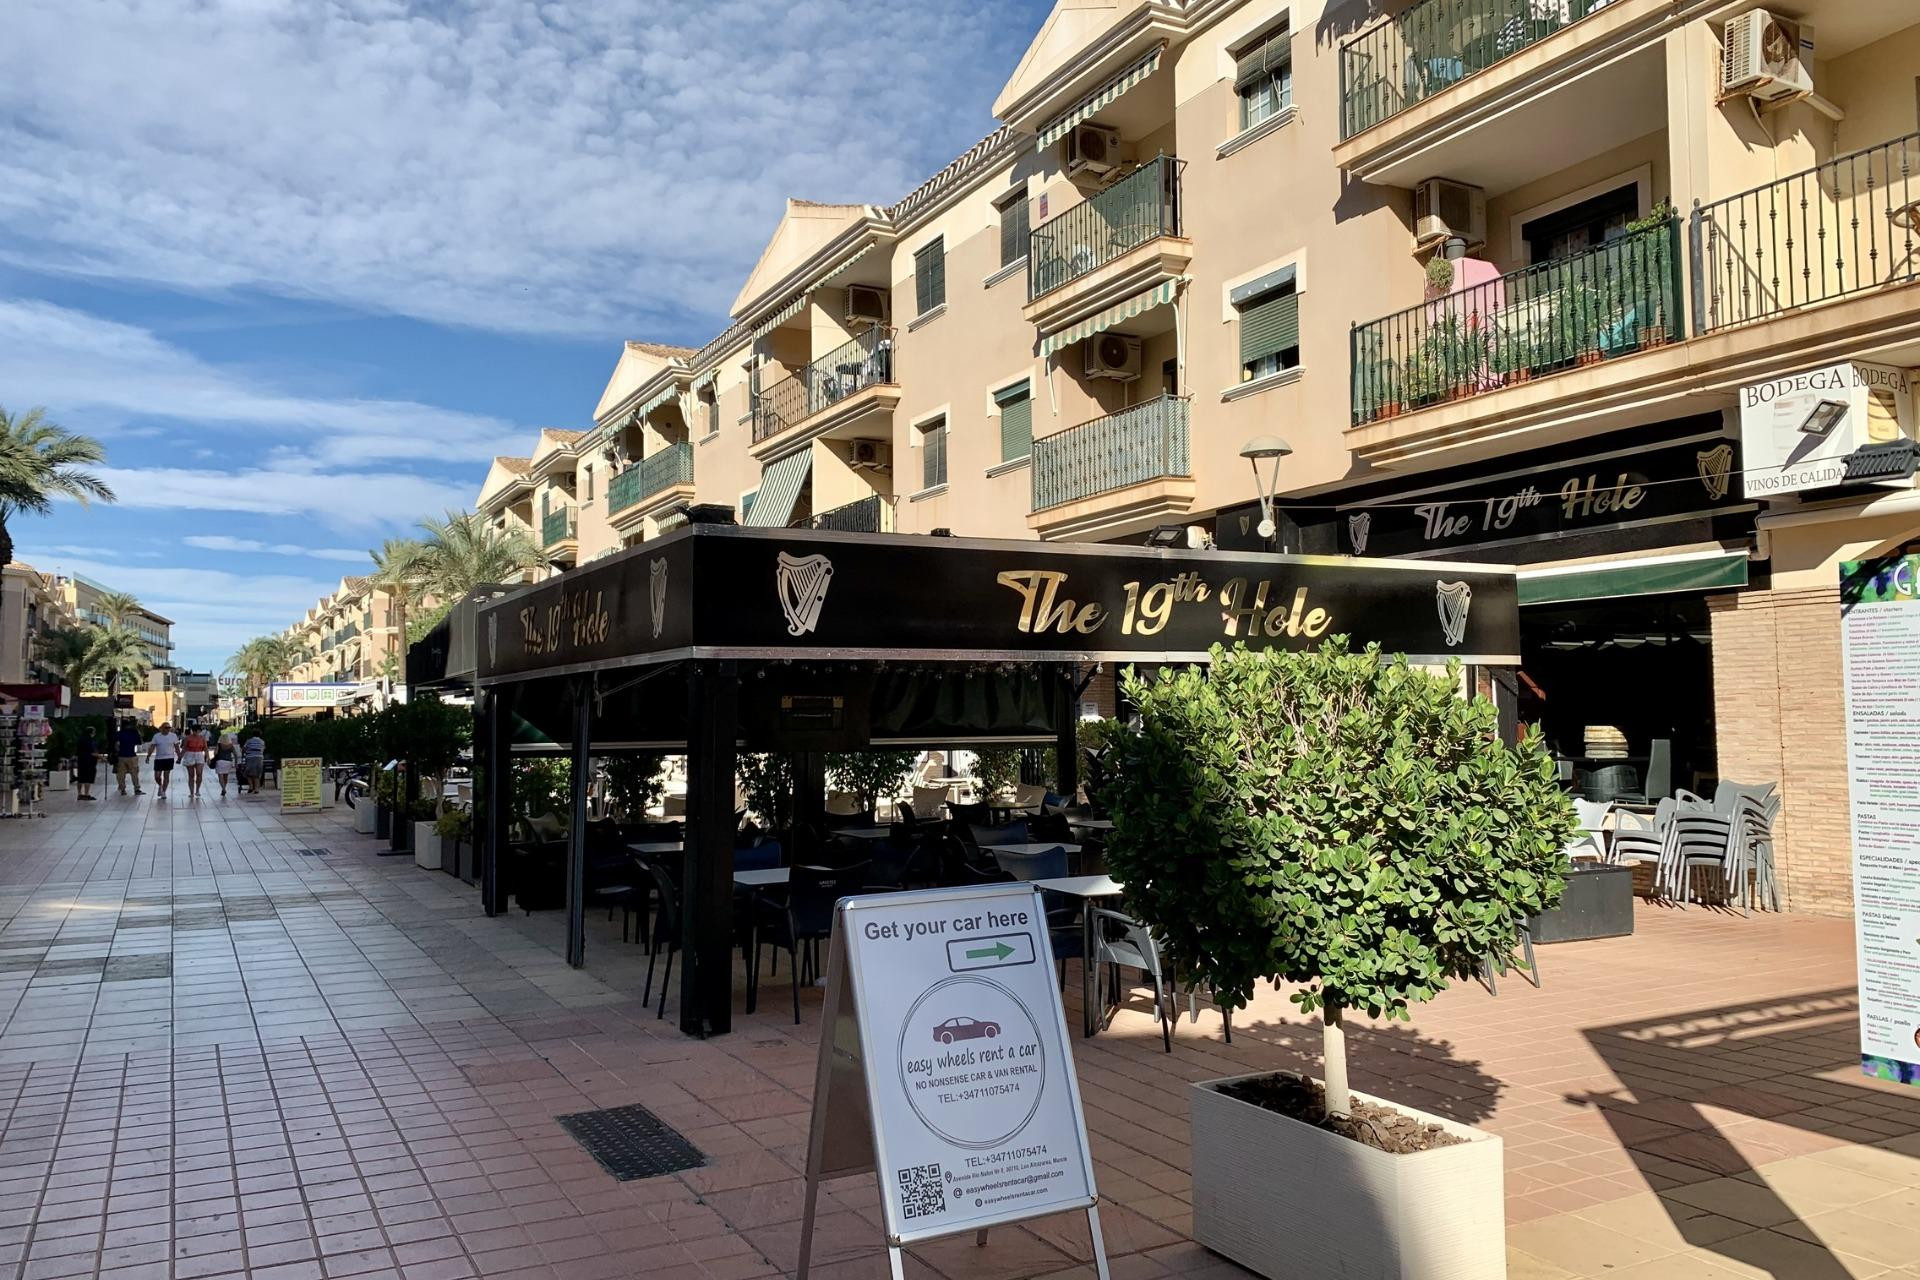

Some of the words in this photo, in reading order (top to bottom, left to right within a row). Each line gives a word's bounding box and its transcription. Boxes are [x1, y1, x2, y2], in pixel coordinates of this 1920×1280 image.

[1746, 368, 1846, 408] BODEGA
[1851, 366, 1908, 394] BODEGA
[1746, 476, 1780, 492] VINOS
[1782, 474, 1798, 487] DE
[1800, 467, 1847, 485] CALIDA
[1414, 502, 1473, 540] The
[1482, 485, 1543, 531] 19th
[1560, 473, 1647, 519] Hole
[997, 570, 1109, 634] The
[1121, 571, 1211, 636] 19th
[1220, 577, 1333, 638] Hole
[1860, 855, 1903, 863] ESPECIALIDADES
[864, 921, 899, 940] Get
[904, 919, 947, 941] your
[952, 916, 982, 932] car
[987, 911, 1028, 928] here
[907, 1059, 932, 1076] easy
[937, 1048, 975, 1069] wheels
[980, 1045, 1004, 1062] rent
[1008, 1047, 1015, 1058] a
[1019, 1043, 1037, 1057] car
[915, 1081, 927, 1090] NO
[928, 1075, 969, 1088] NONSENSE
[970, 1071, 987, 1082] CAR
[987, 1071, 994, 1079] &
[994, 1068, 1009, 1079] VAN
[1010, 1064, 1038, 1076] RENTAL
[938, 1082, 1020, 1104] TEL:+34711075474
[965, 1145, 1047, 1168] TEL:+34711075474
[953, 1174, 971, 1182] Avenida
[966, 1169, 1064, 1195] easywheelsrentacar@gmail.com
[984, 1186, 1048, 1204] easywheelsrentacar.com
